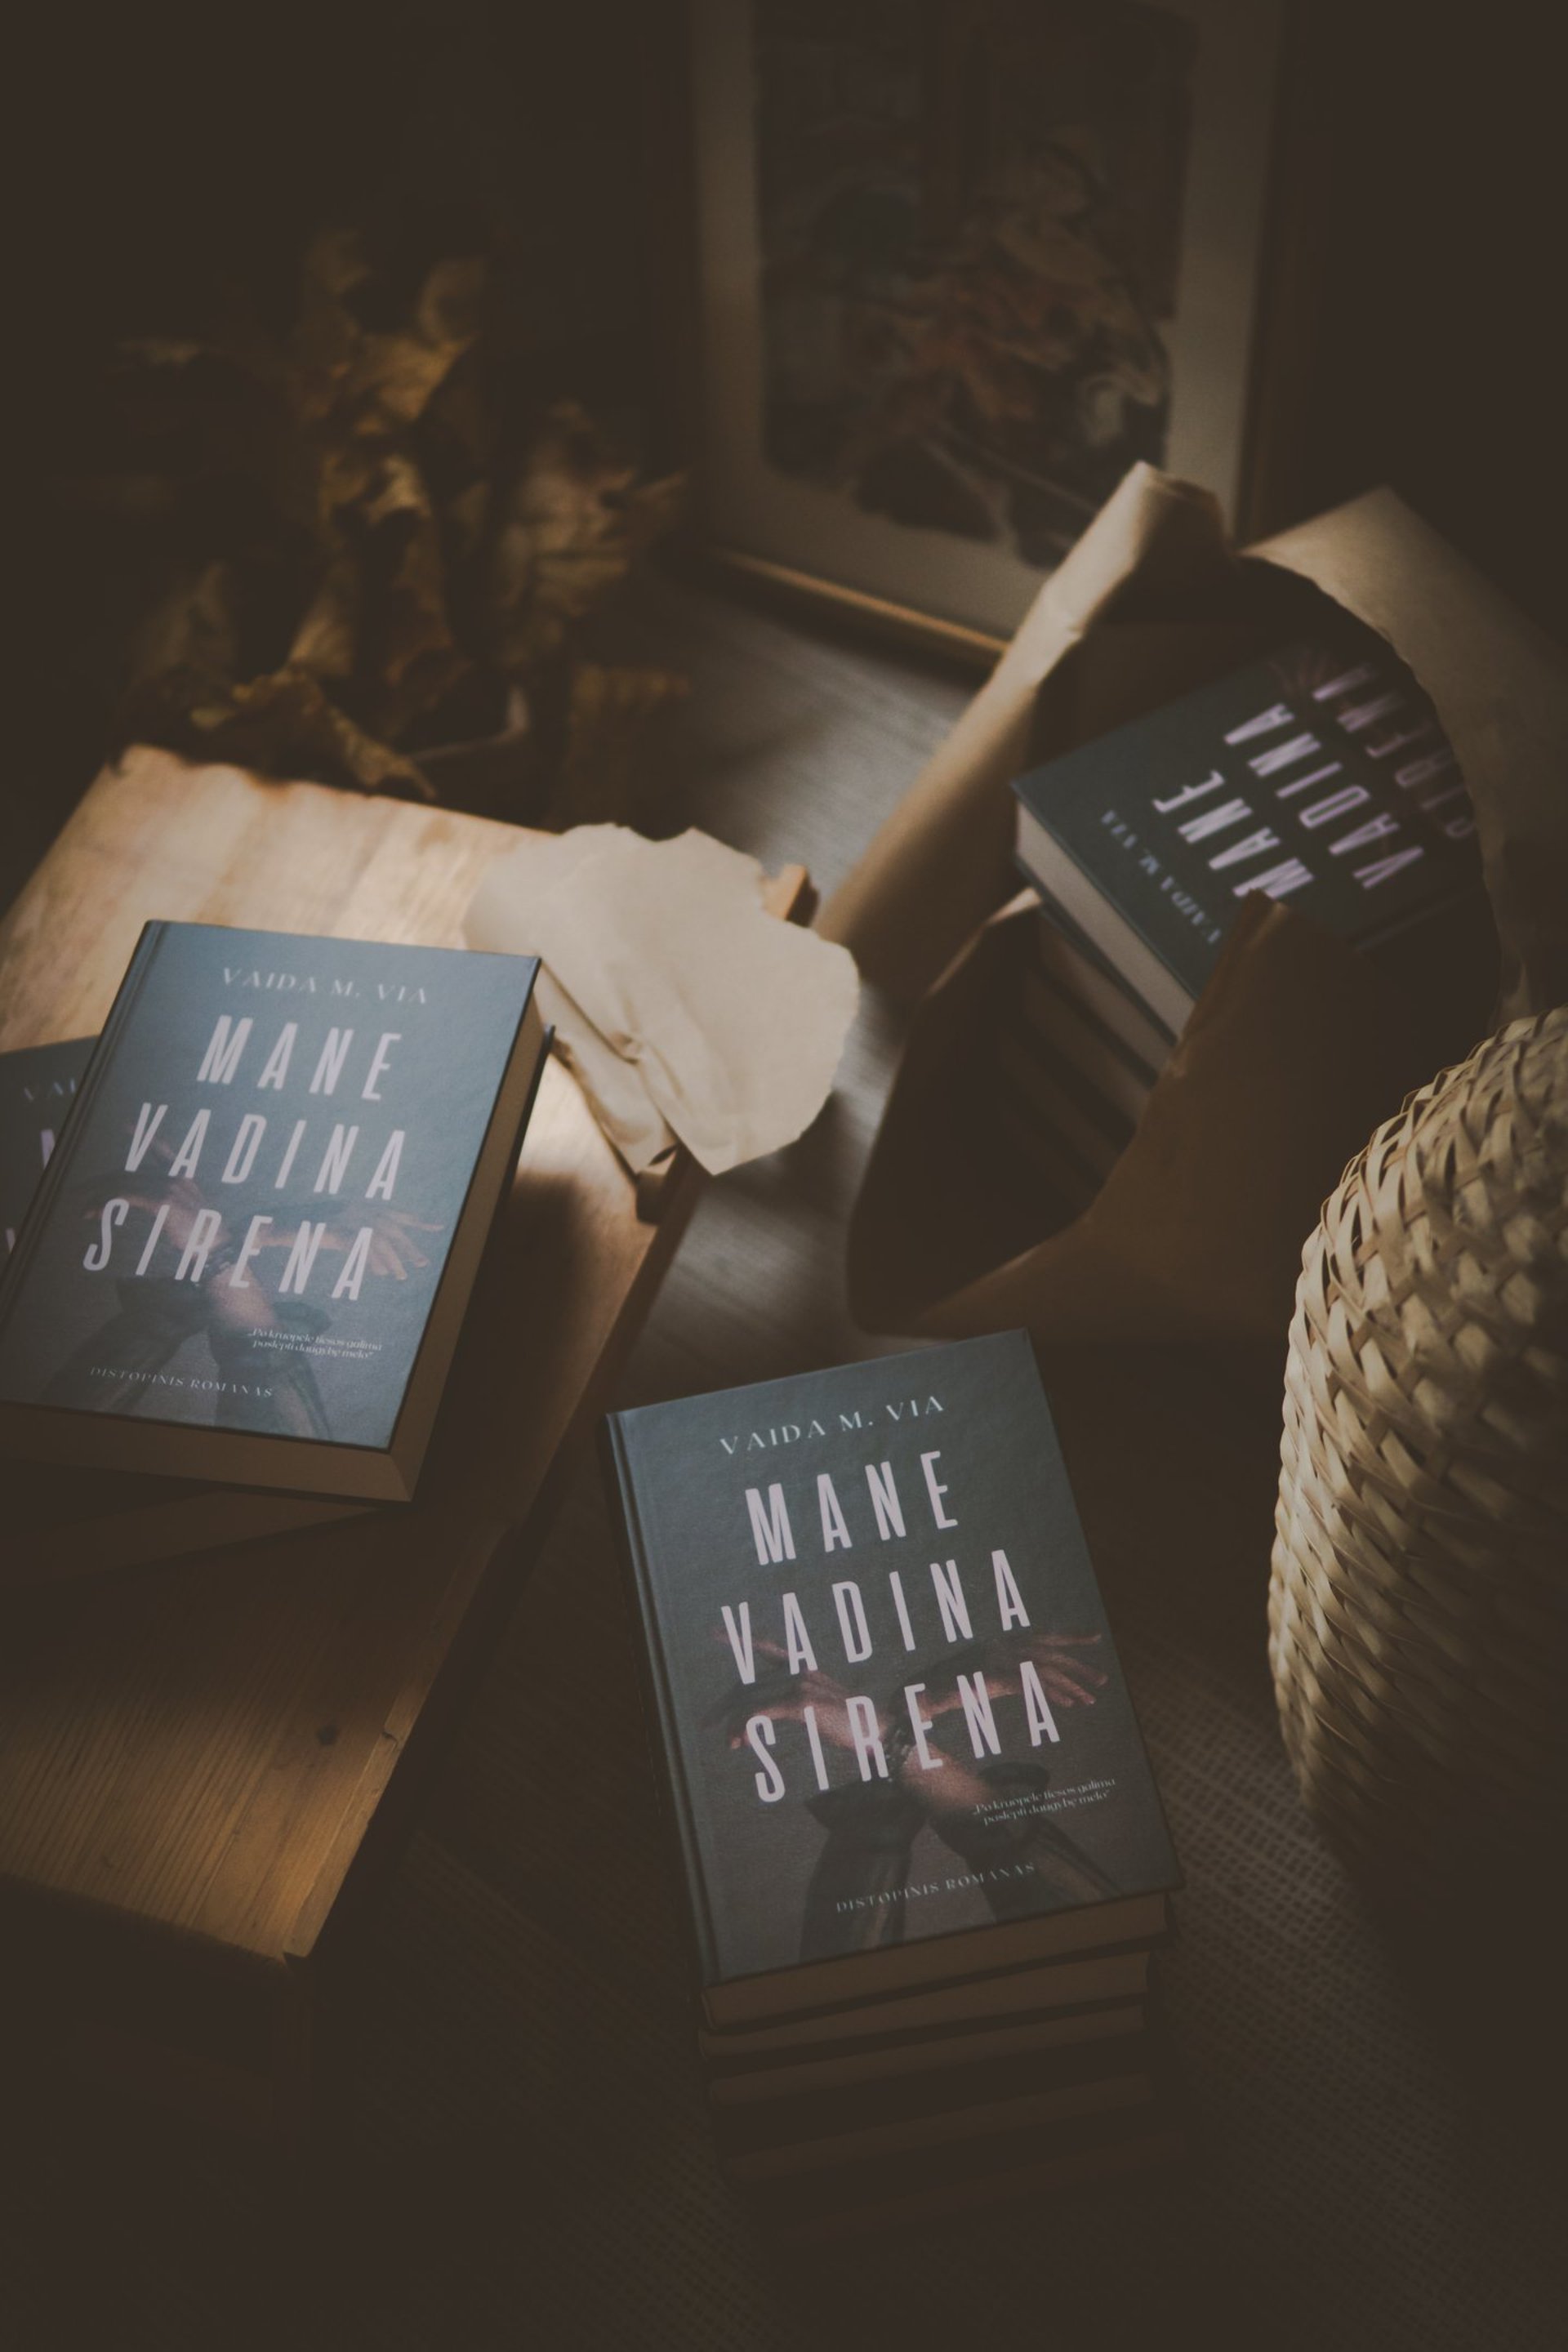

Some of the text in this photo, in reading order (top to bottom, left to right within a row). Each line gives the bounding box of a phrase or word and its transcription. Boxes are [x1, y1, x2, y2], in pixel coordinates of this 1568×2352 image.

[1152, 768, 1314, 901] MANE
[1223, 702, 1425, 890] VADINA
[222, 966, 427, 1004] VAIDA M. VIA
[197, 1014, 402, 1102] MANE
[124, 1102, 406, 1201] VADINA
[82, 1198, 374, 1301] SIRENA
[90, 1366, 274, 1398] DISTOPINIS ROMANAS
[719, 1394, 946, 1456] VAIDA M. VIA
[745, 1450, 959, 1566] MANE
[720, 1548, 1032, 1685] VADINA
[744, 1660, 1062, 1805] SIRENA
[835, 1861, 1036, 1913] DISTOPINIS ROMANAS
